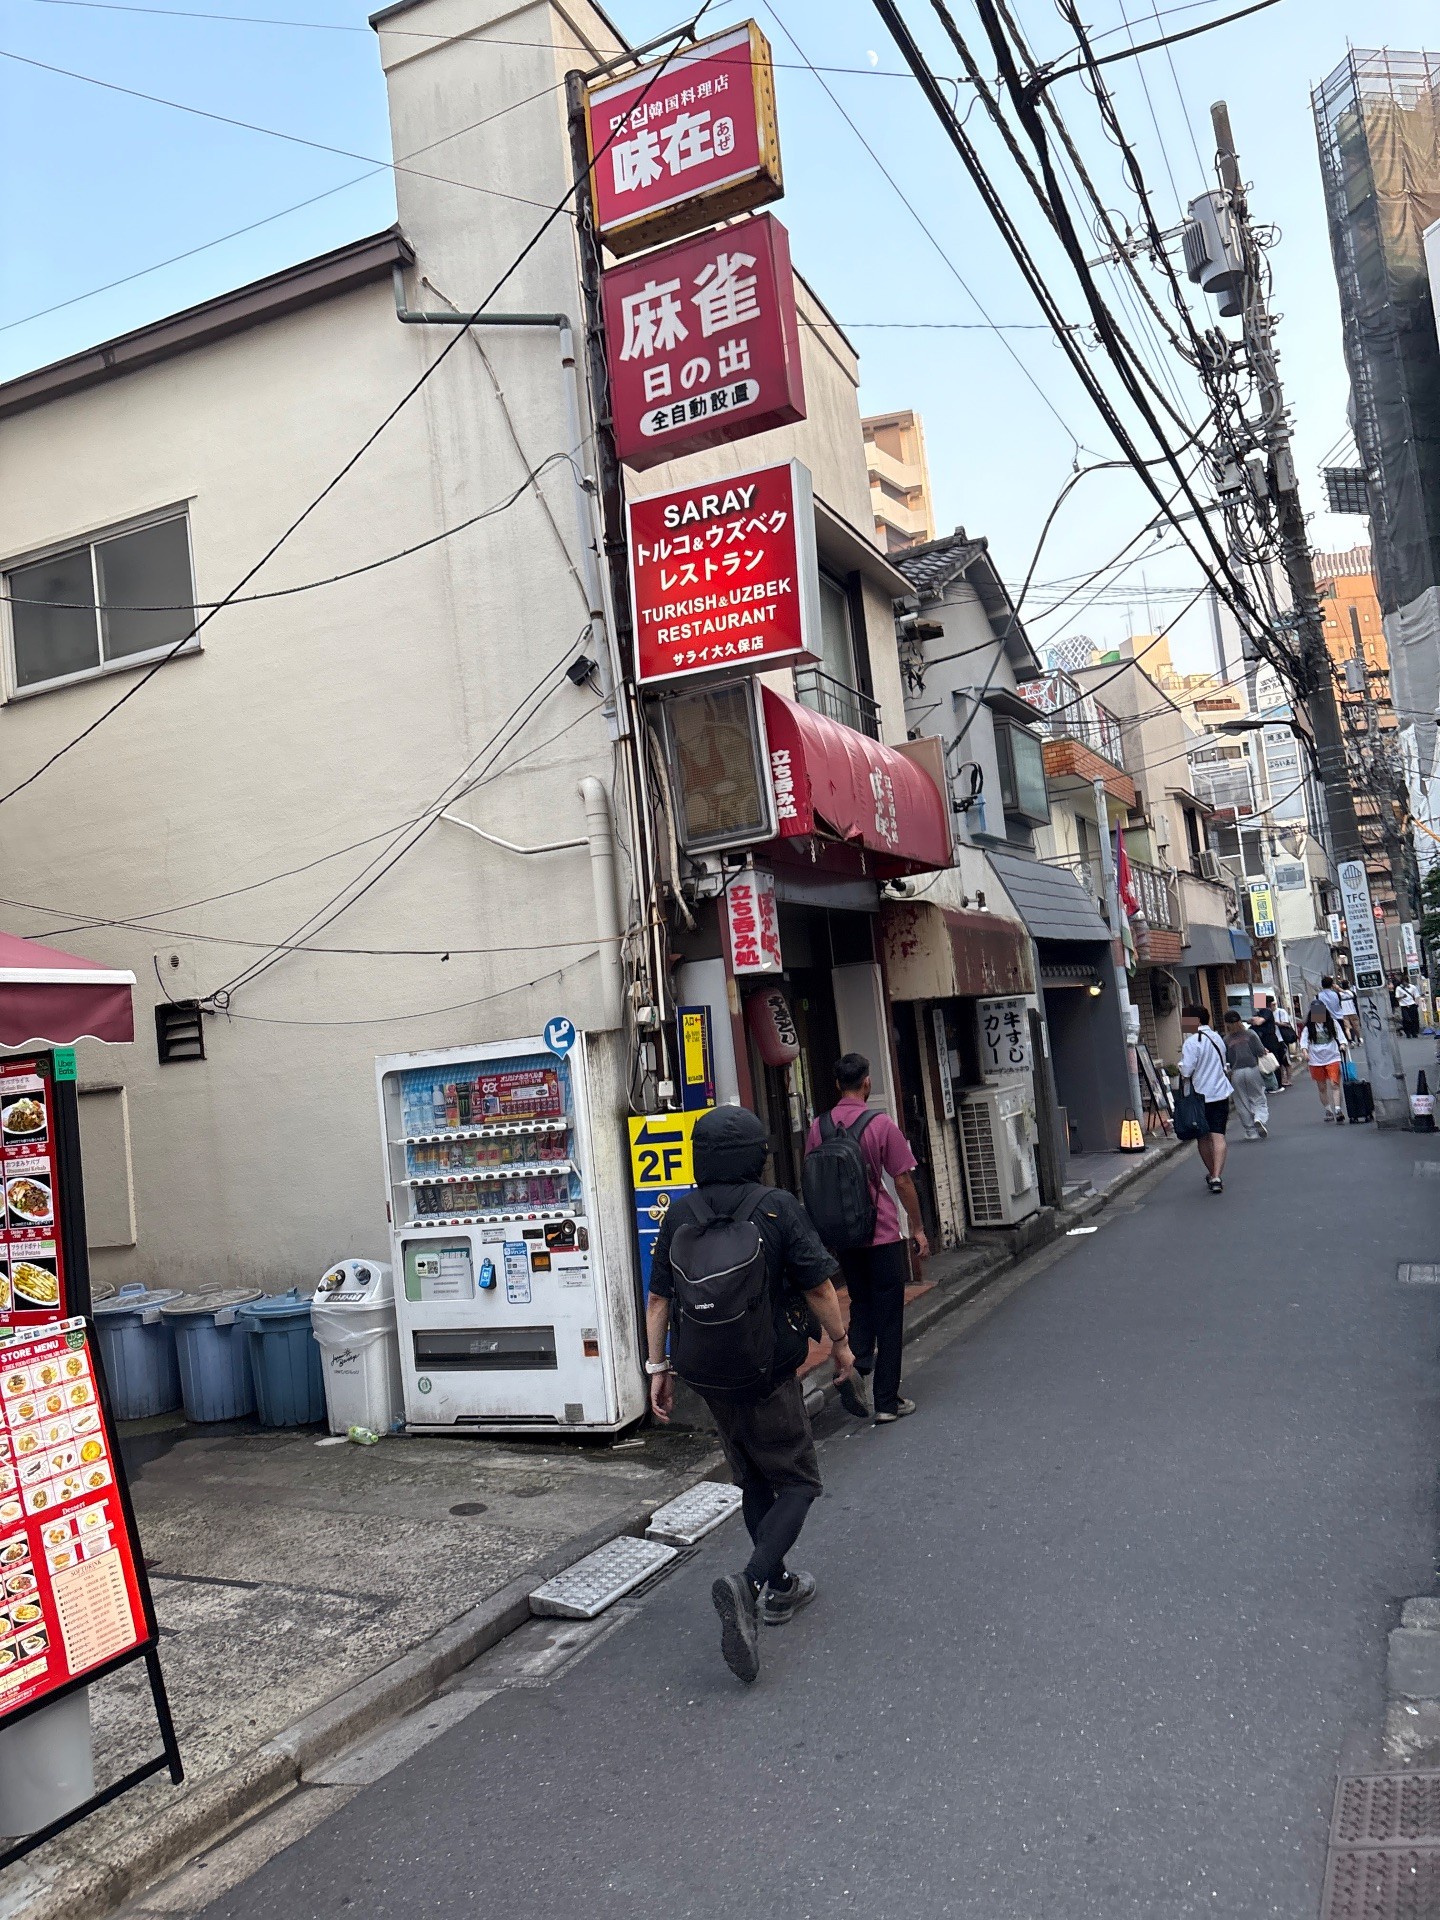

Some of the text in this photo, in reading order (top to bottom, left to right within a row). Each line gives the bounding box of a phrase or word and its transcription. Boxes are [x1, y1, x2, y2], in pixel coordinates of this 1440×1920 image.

[649, 75, 729, 119] 韓国料理店
[612, 110, 714, 194] 味在
[717, 122, 731, 151] あぜ
[619, 252, 761, 361] 麻雀
[643, 338, 750, 402] 日の出
[651, 382, 750, 431] 全自動設置
[664, 484, 756, 528] SARAY
[637, 510, 788, 567] トルコ&ウズベク
[660, 549, 764, 591] レストラン
[642, 578, 792, 624] TURKISH&UZBEK
[658, 605, 777, 644] RESTAURANT
[673, 636, 764, 666] サライ大久保店
[1346, 892, 1366, 903] TFC
[730, 885, 760, 967] 立ち呑み処
[549, 1020, 569, 1048] ピ
[984, 1014, 1001, 1065] カレー
[1004, 1011, 1024, 1063] 牛すじ
[6, 1159, 40, 1168] おつまみケバブ
[638, 1148, 682, 1182] 2F
[1, 1340, 59, 1362] STORE MENU
[62, 1501, 85, 1514] Dessert
